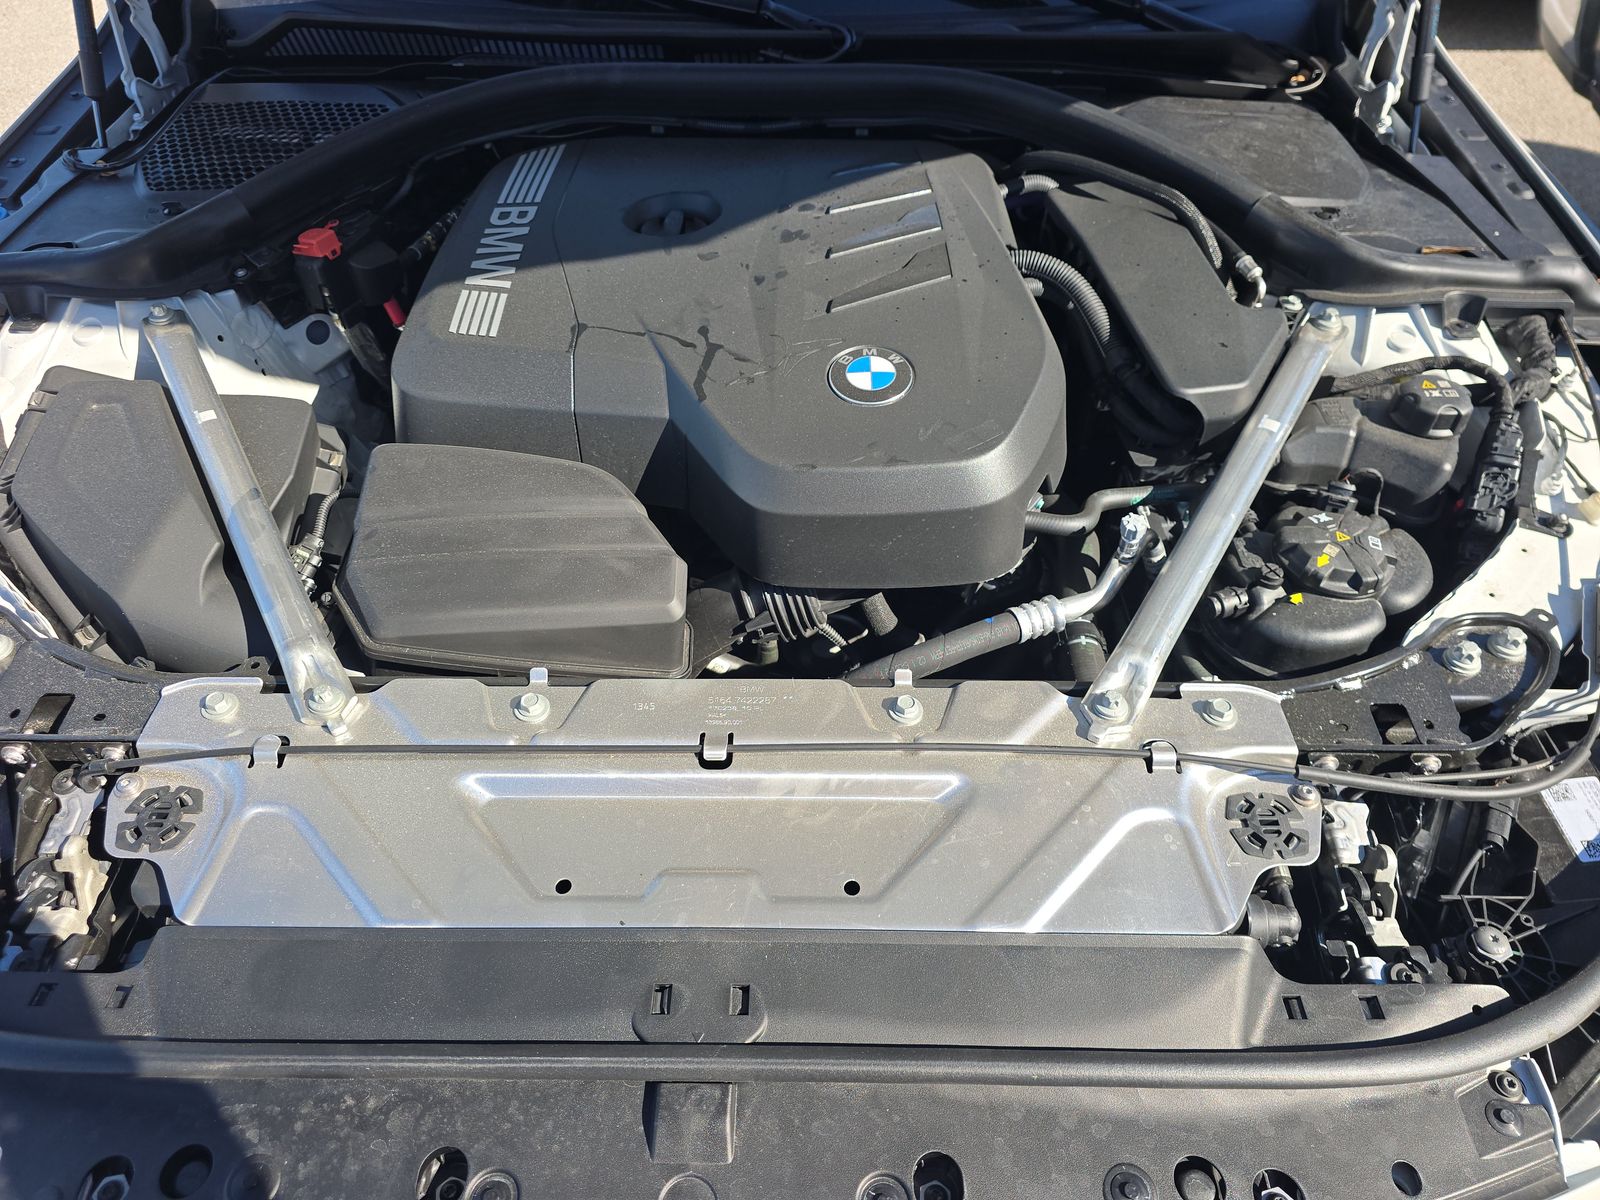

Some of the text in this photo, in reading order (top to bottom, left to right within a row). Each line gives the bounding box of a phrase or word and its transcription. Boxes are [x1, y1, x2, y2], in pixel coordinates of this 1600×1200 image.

[464, 206, 538, 289] BMW
[838, 348, 904, 365] BMW
[740, 685, 765, 694] BMW
[632, 702, 656, 711] 1345
